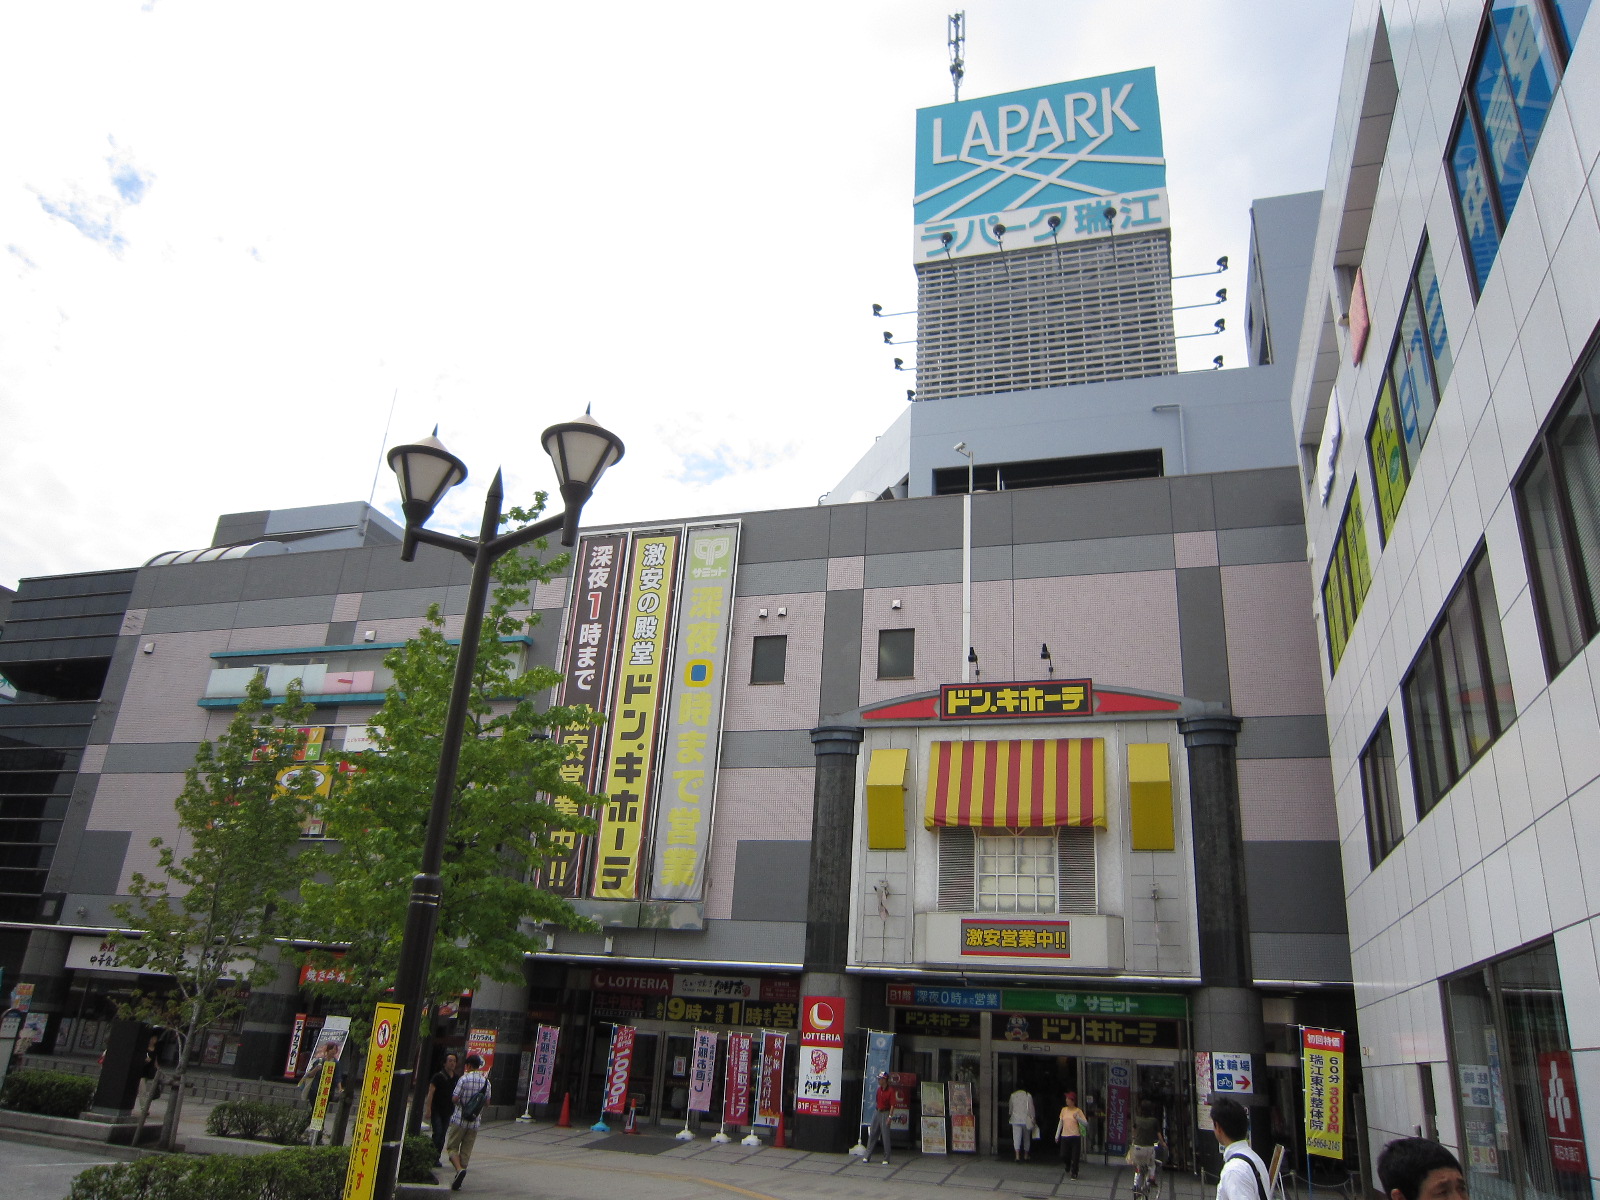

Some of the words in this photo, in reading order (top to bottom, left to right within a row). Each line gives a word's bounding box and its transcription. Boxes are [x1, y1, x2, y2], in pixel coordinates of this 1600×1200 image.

[933, 83, 1140, 165] LAPARK
[921, 194, 1162, 257] ラパーク瑞江
[691, 566, 728, 579] サミット
[573, 544, 613, 691] 深夜1時まで
[630, 543, 667, 667] 激安の殿堂
[661, 586, 724, 888] 深夜0時まで営業
[965, 928, 1066, 950] 激安営業中!!
[608, 977, 670, 991] LOTTERIA
[889, 989, 912, 1002] B1階
[916, 988, 998, 1007] 深夜0時まで営業
[1083, 994, 1139, 1013] サミット
[802, 1031, 841, 1042] LOTTERIA
[1306, 1034, 1341, 1048] 初回特価
[736, 1037, 750, 1118] 現金買取フェア
[1215, 1058, 1250, 1072] 駐輪場
[1328, 1056, 1340, 1084] 60分
[1309, 1054, 1324, 1131] 瑞江東洋整体院
[355, 1053, 383, 1191] 条例違反です
